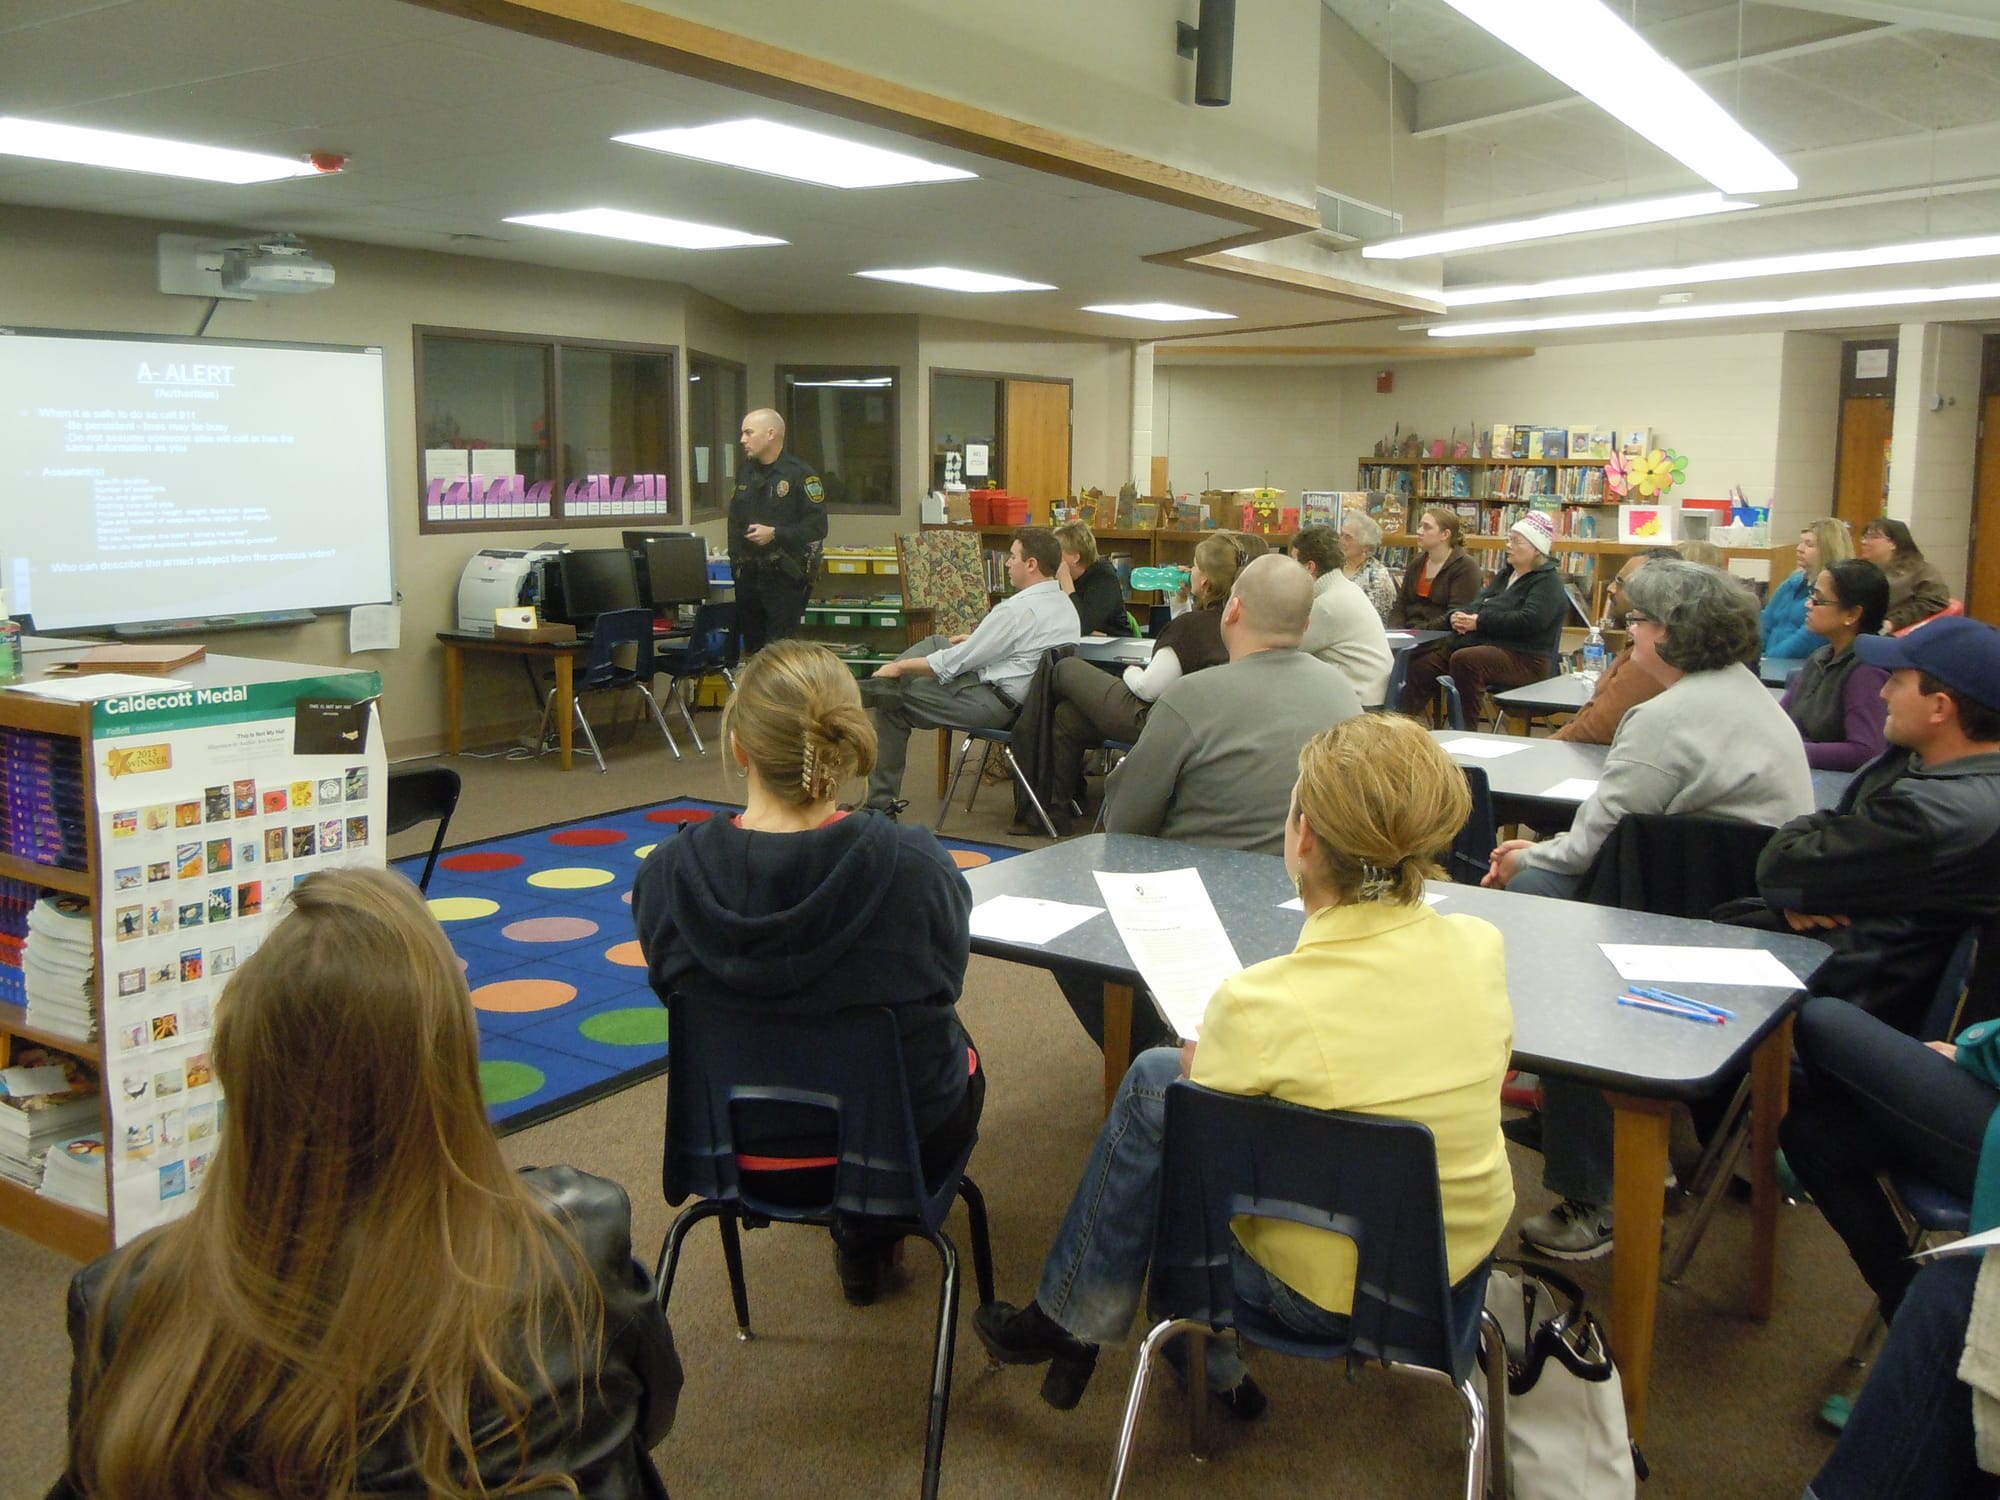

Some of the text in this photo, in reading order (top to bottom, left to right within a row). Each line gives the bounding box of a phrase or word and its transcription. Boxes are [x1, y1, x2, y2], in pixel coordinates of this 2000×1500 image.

[136, 361, 235, 384] A- ALERT
[104, 685, 248, 715] Caldecott Medal
[105, 727, 131, 737] Follett
[137, 748, 158, 760] 2013
[127, 755, 169, 769] WINNER
